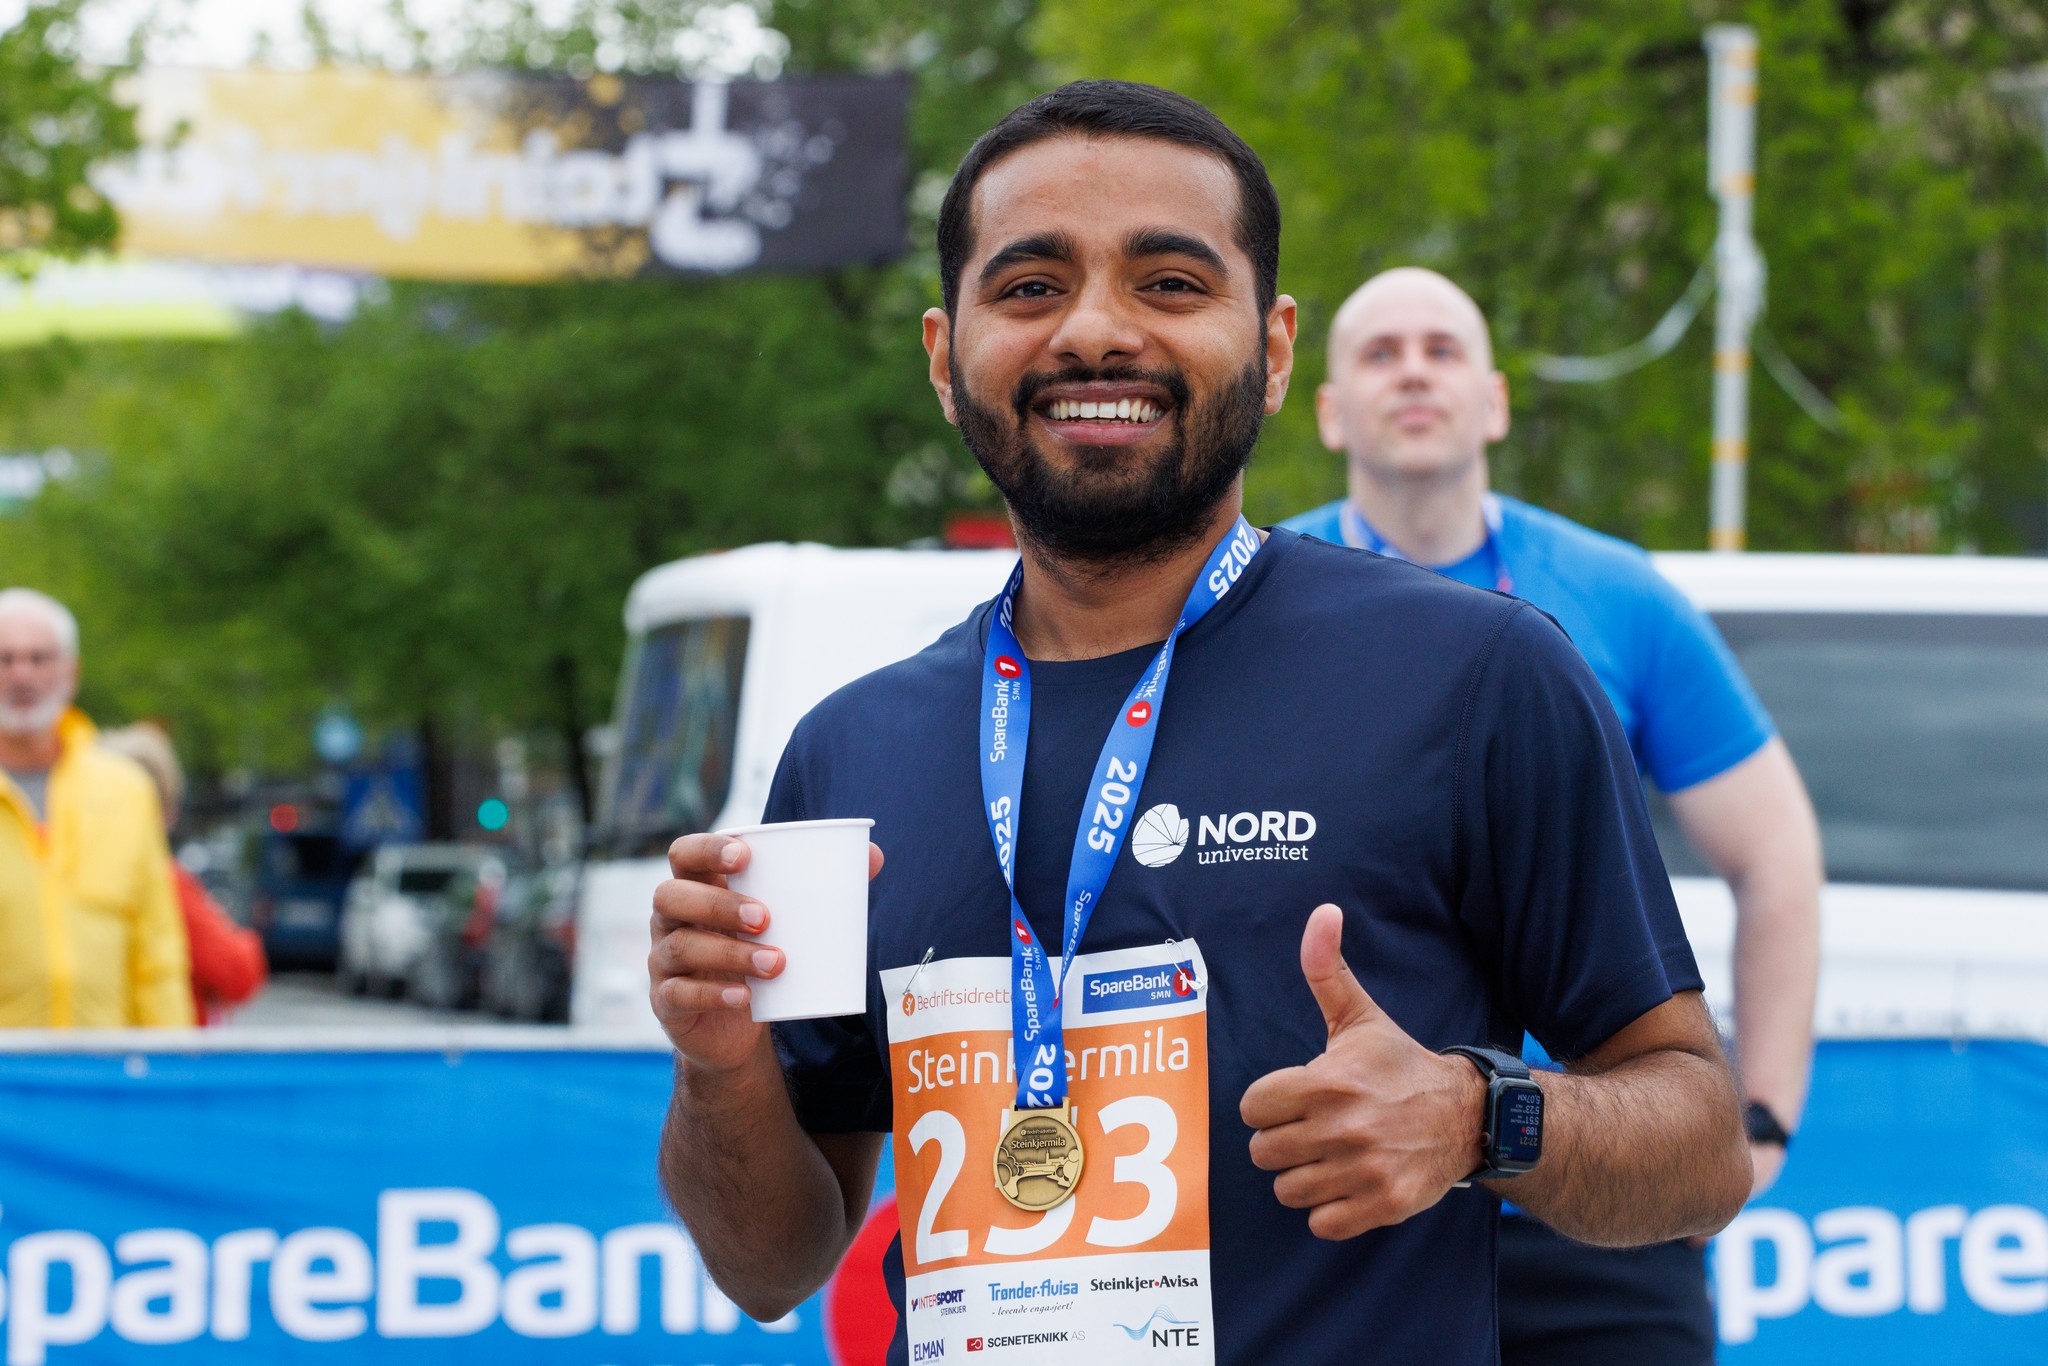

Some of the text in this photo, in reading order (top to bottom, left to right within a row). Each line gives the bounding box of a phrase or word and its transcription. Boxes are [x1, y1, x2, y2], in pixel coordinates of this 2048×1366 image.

[1208, 523, 1257, 601] 2025
[1011, 681, 1021, 700] SMN
[990, 679, 1011, 763] SpareBank
[1087, 756, 1138, 855] 2025
[1198, 811, 1317, 845] NORD
[990, 796, 1011, 888] 2025
[1198, 844, 1309, 865] universitet
[1033, 947, 1042, 970] SMN
[1020, 946, 1042, 1042] SpareBank
[1090, 972, 1171, 998] SpareBank
[1151, 990, 1172, 1000] SMN
[918, 987, 1012, 1011] Bedriftsidrett
[908, 1026, 1189, 1094] Steinermila
[1027, 1044, 1057, 1108] 202
[1011, 1137, 1066, 1149] Steinkjermila
[0, 1188, 798, 1366] pareBan
[1715, 1204, 2048, 1345] pare
[918, 1289, 964, 1310] INTERSPORT
[988, 1278, 1079, 1301] Trønder-Avisa
[940, 1305, 967, 1317] STEINKJER
[997, 1303, 1028, 1316] levende
[1029, 1301, 1074, 1316] engasjert!
[987, 1330, 1086, 1348] SCENETEKNIKK AS
[1152, 1328, 1200, 1348] NTE
[914, 1339, 945, 1362] ELMAN
